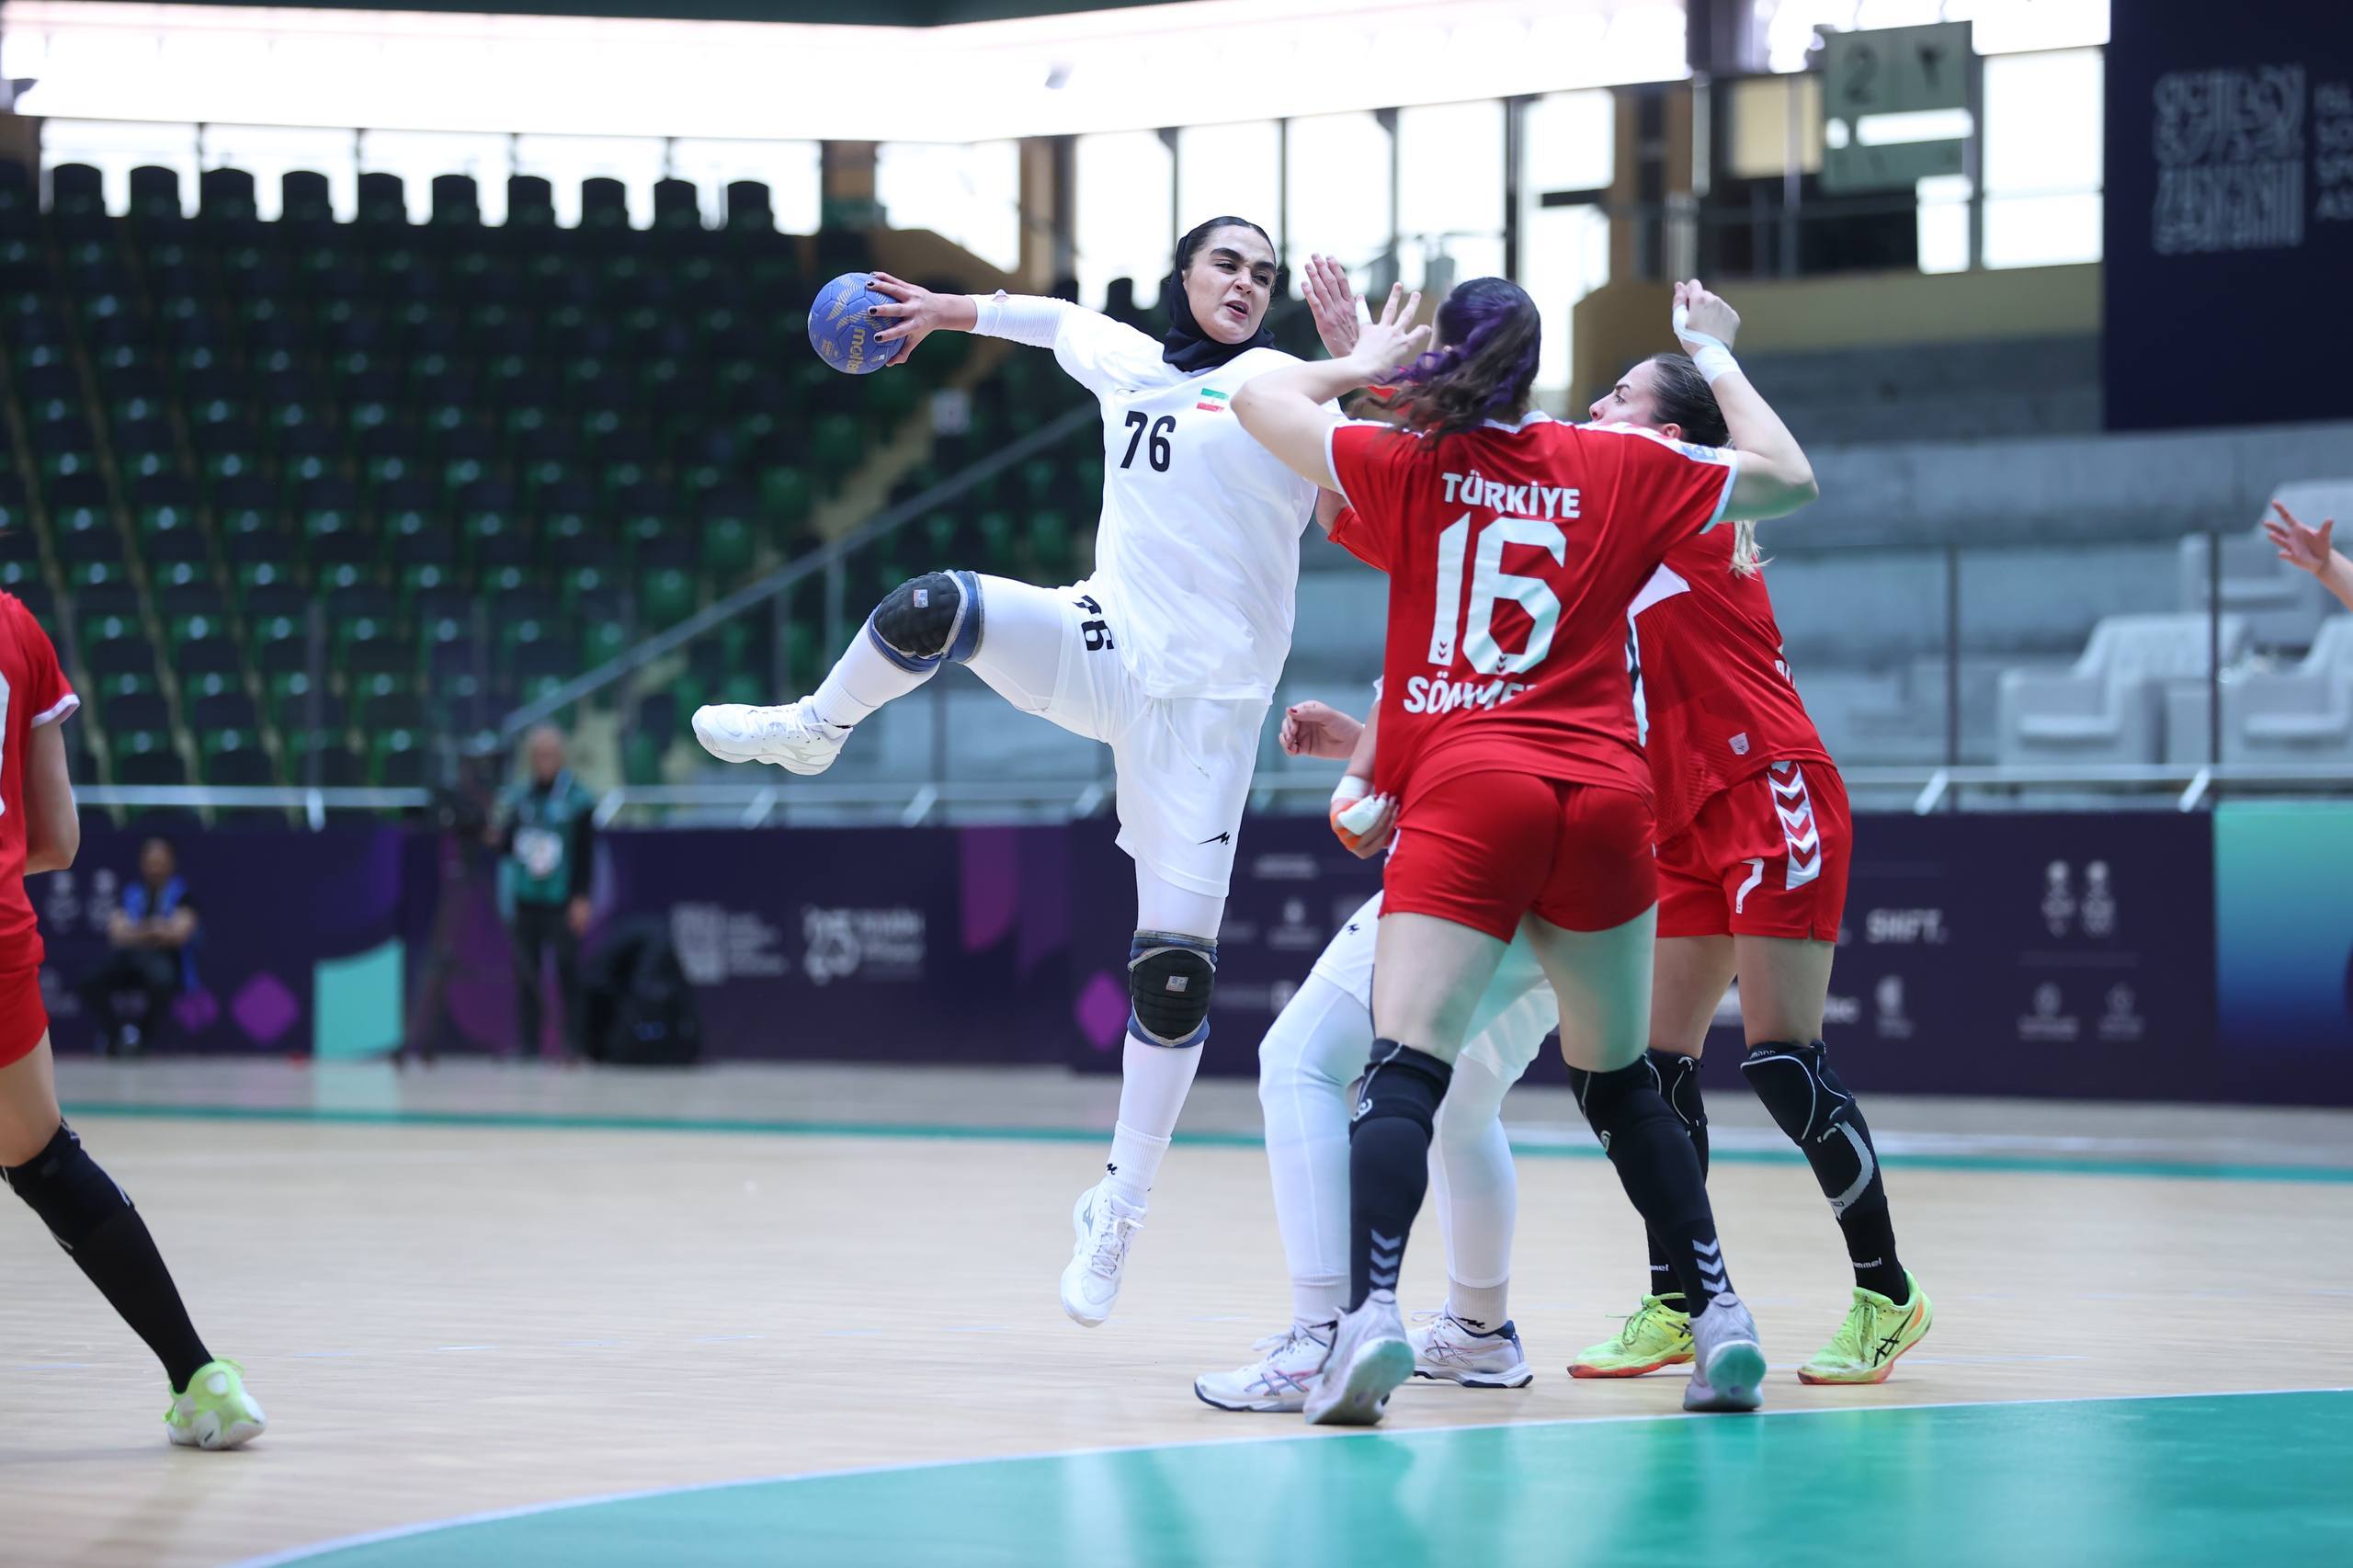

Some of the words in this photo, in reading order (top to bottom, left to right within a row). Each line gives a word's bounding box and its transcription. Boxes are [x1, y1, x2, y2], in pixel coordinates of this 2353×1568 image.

[845, 328, 866, 373] molte
[1120, 410, 1176, 472] 76
[1441, 469, 1581, 520] TÜRKİYE
[1428, 511, 1566, 675] 16
